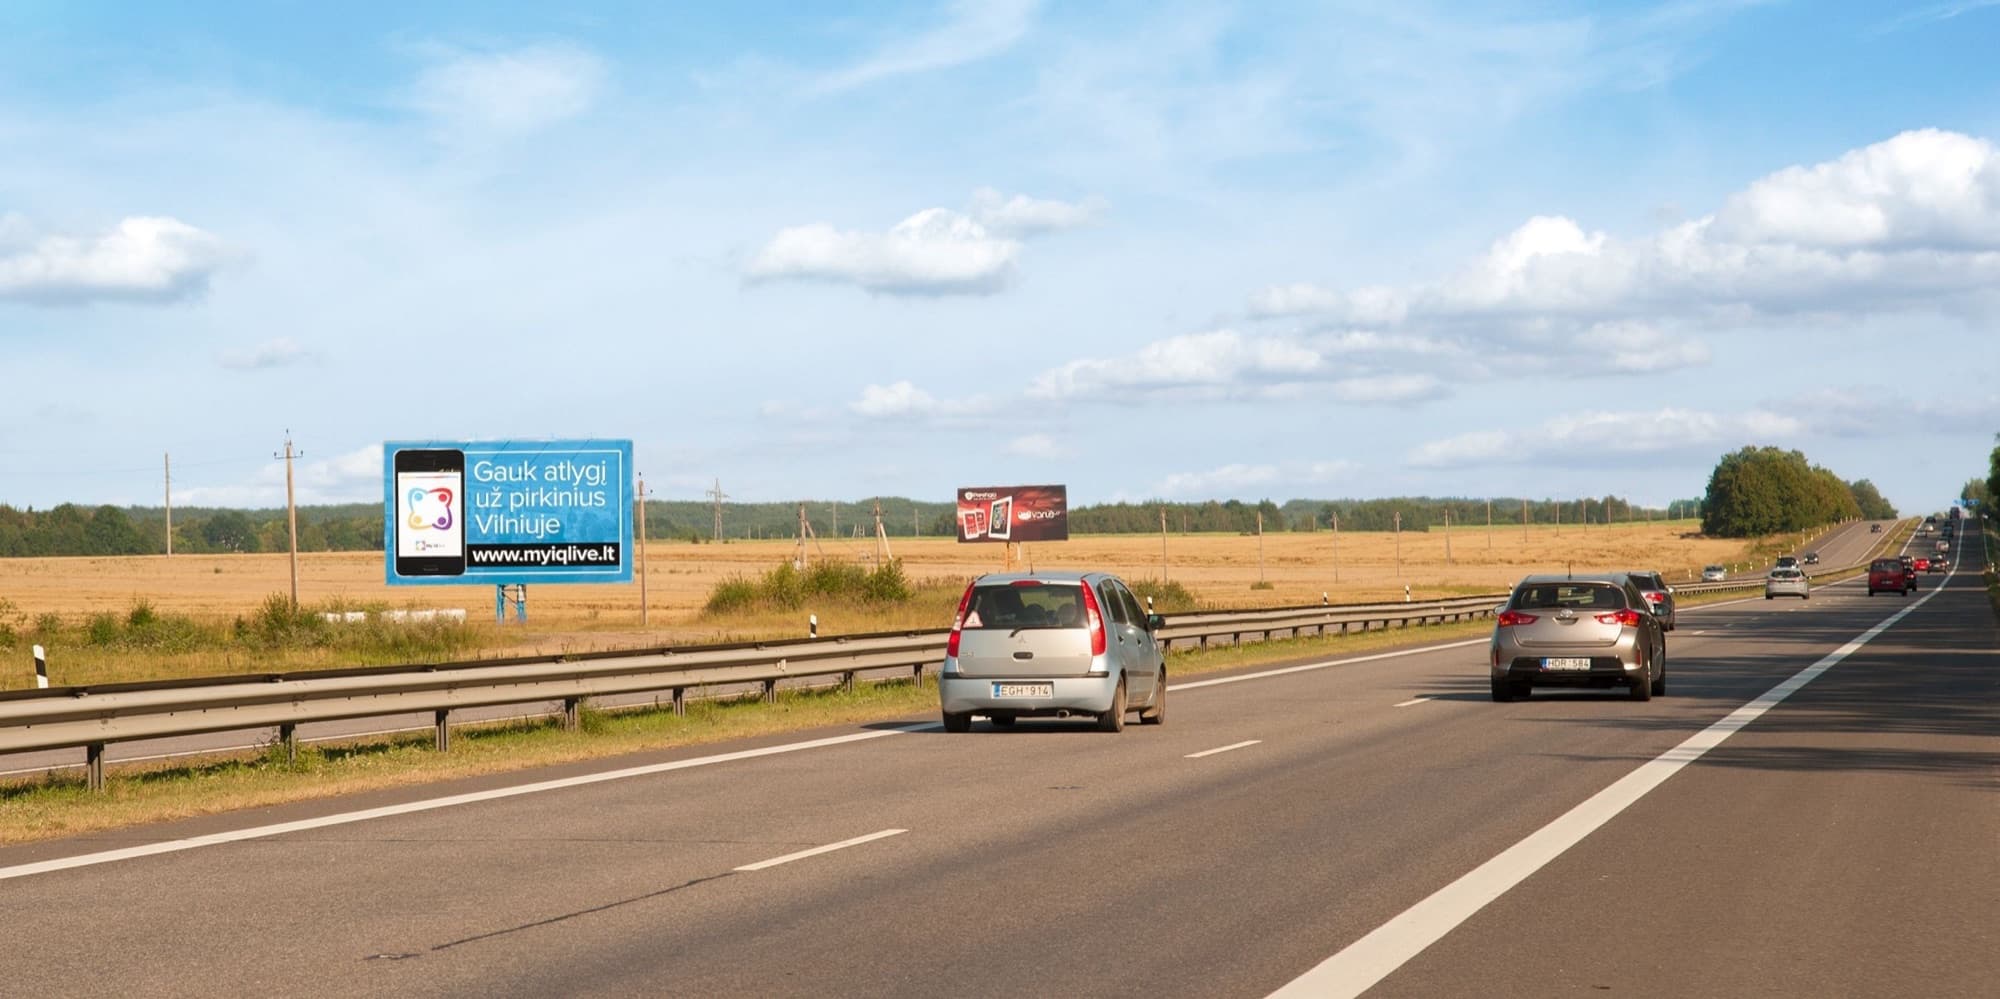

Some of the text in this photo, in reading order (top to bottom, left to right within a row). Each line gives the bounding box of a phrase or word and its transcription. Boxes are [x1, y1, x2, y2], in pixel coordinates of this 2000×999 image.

[474, 460, 607, 486] Gauk atlygį
[476, 486, 606, 512] už pirkinius
[475, 514, 560, 539] Vilniuje
[472, 545, 615, 565] www.myiqlive.lt
[1001, 686, 1048, 696] EGH 914
